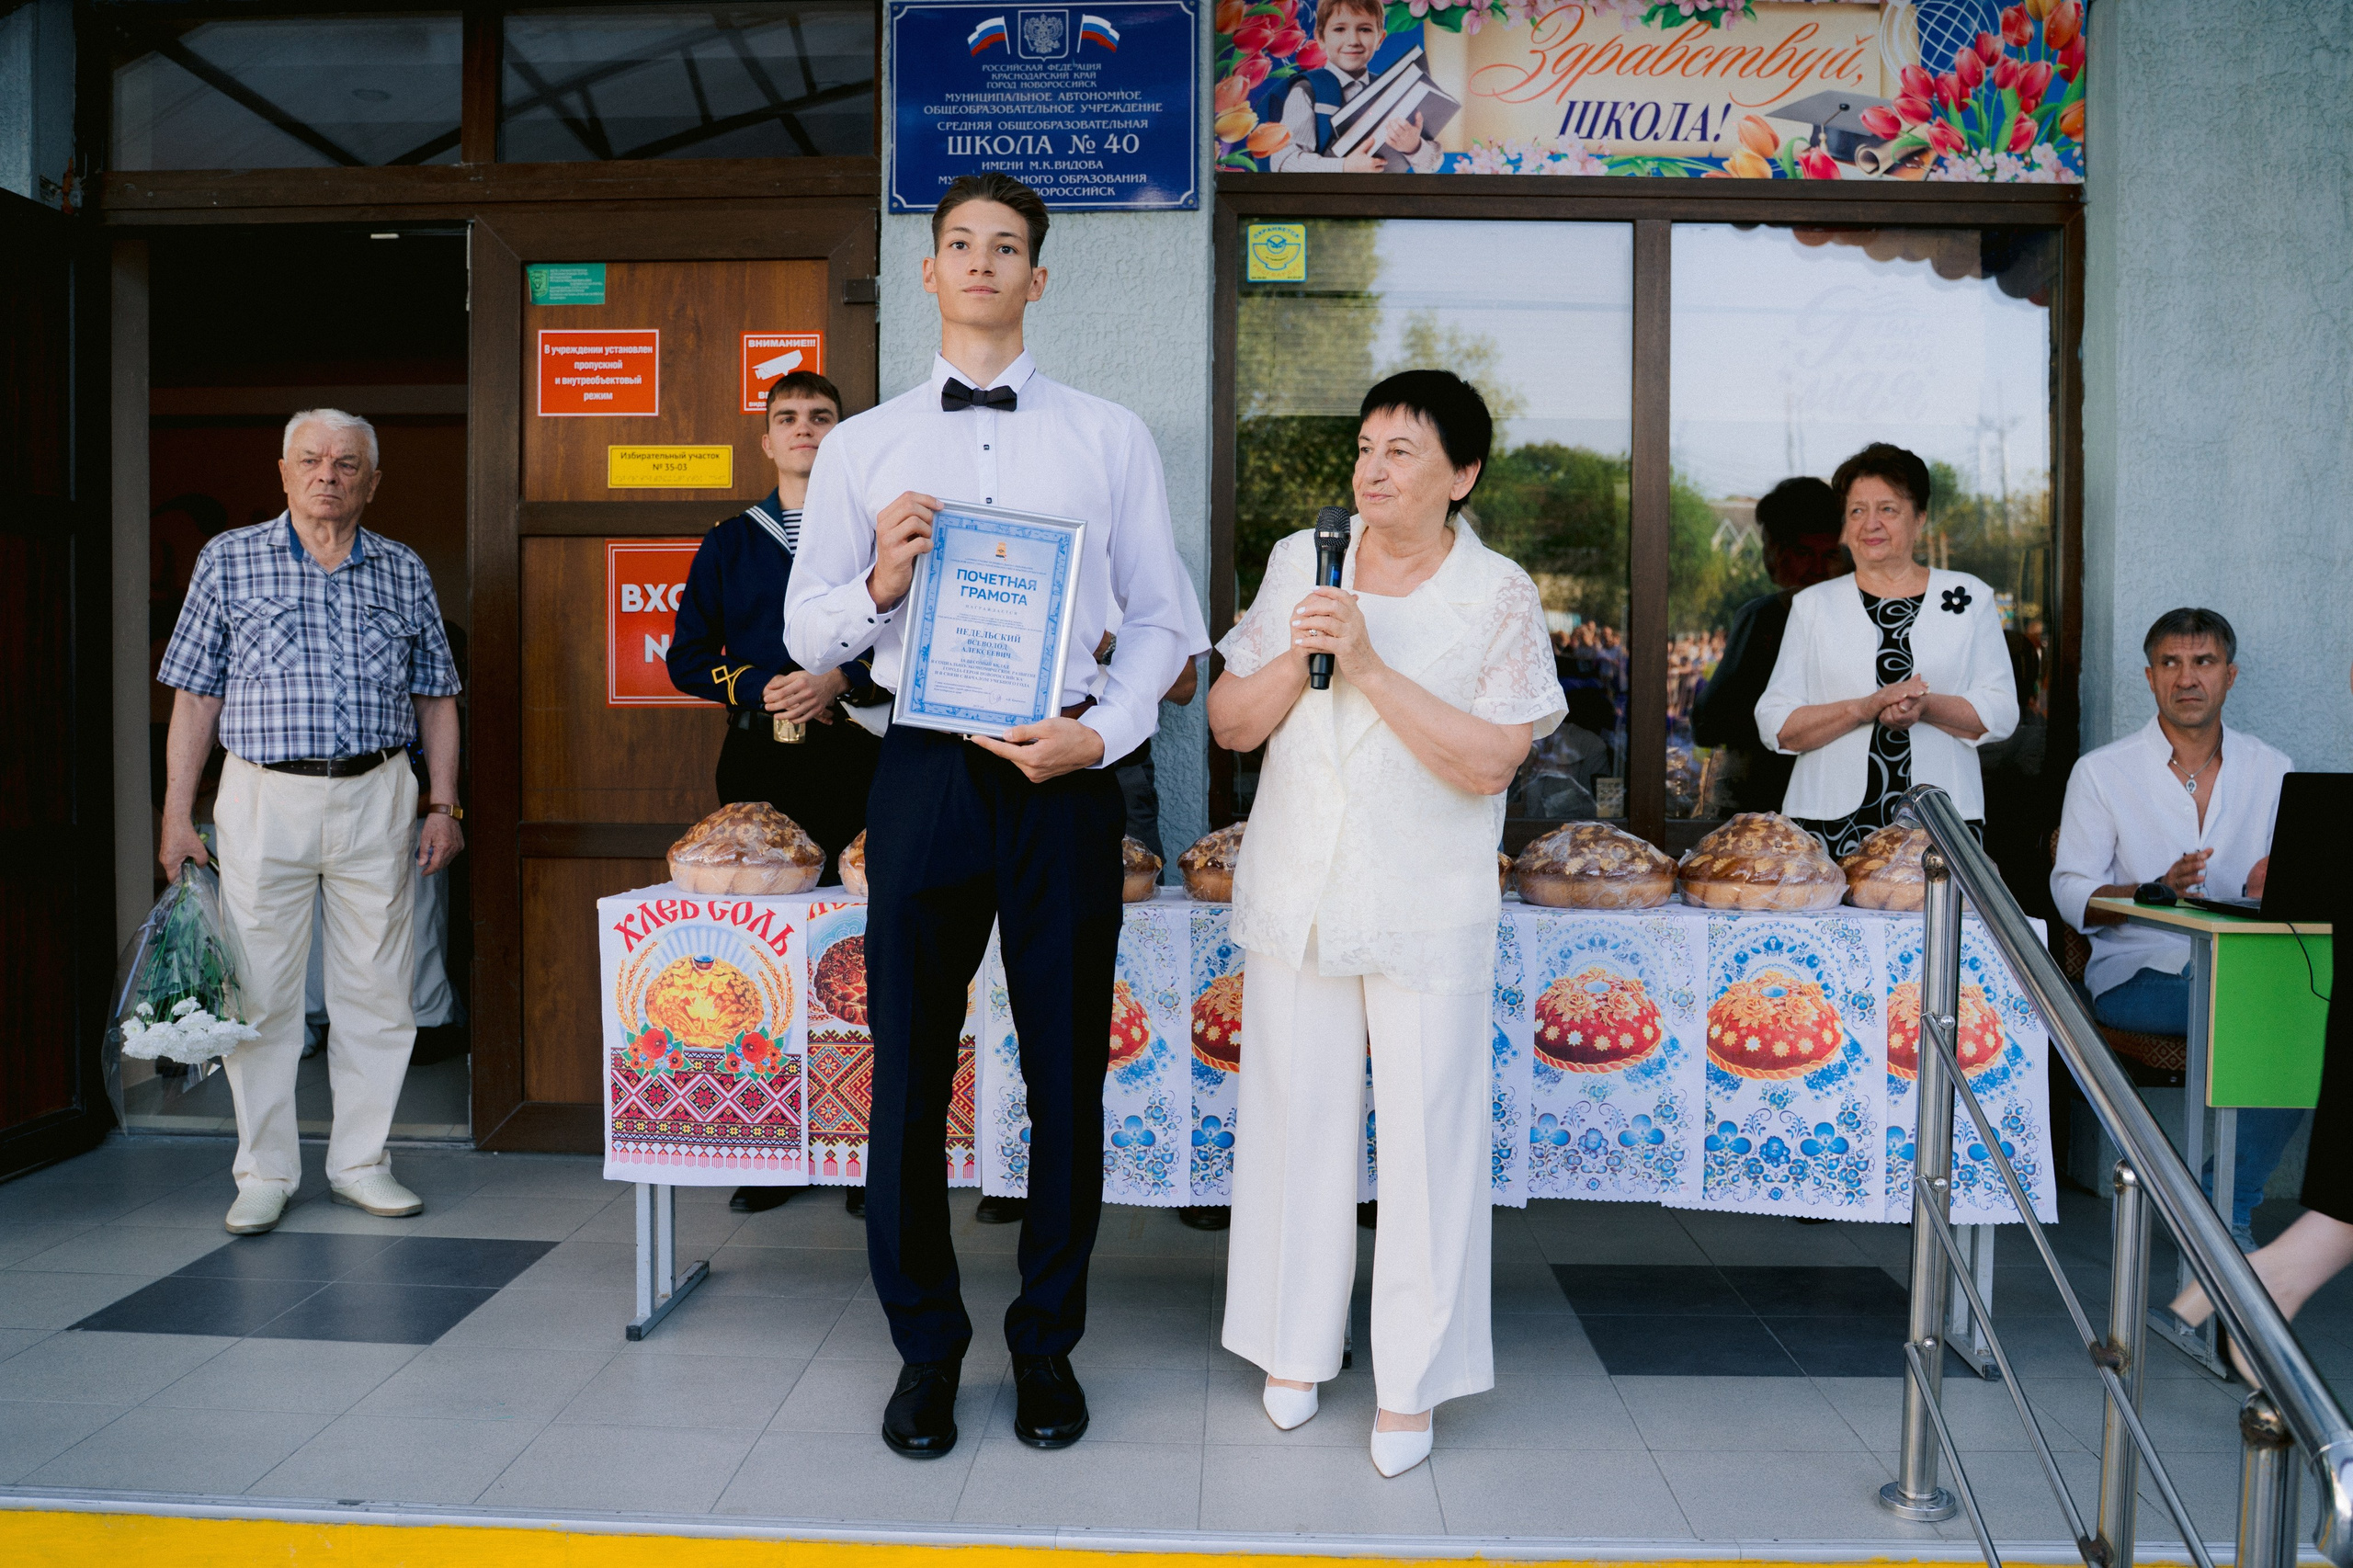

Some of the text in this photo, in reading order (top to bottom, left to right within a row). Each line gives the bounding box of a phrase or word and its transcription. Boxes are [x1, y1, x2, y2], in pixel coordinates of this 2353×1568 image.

[1469, 4, 1875, 108] Здравствуй,
[982, 62, 1102, 73] РОССИЙСКАЯ ФЕДЕРАЦИЯ
[991, 71, 1097, 81] КРАСНОДАРСКИЙ КРАЙ
[986, 80, 1097, 89] ГОРОД НОВОРОССИЙСК
[945, 90, 1142, 103] МУНИЦИПАЛЬНОЕ АВТОНОМНОЕ
[923, 102, 1164, 115] ОБЩЕОБРАЗОВАТЕЛЬНОЕ УЧРЕЖДЕНИЕ
[937, 119, 1149, 131] СРЕДНЯЯ ОБЩЕОБРАЗОВАТЕЛЬНАЯ
[1555, 99, 1733, 142] ШКОЛА!
[948, 133, 1141, 155] ШКОЛА № 40
[982, 160, 1104, 171] ИМЕНИ М.К.ВИДОВА
[1058, 173, 1148, 185] ОБРАЗОВАНИЯ
[1035, 187, 1116, 198] ВОРОССИЙСК
[748, 339, 816, 348] ВНИМАНИЕ!!!
[544, 345, 654, 357] В учреждении установлен
[574, 359, 623, 371] пропускной
[583, 392, 613, 402] режим
[620, 451, 720, 461] Избирательный участок
[653, 463, 688, 472] № 35-03
[956, 568, 1038, 591] ПОЧЕТНАЯ
[961, 585, 1028, 607] ГРАМОТА
[956, 627, 1021, 644] НЕДЕЛЬСКИЙ
[967, 639, 1008, 652] ВСЕВОЛОД
[961, 646, 1012, 659] АЛЕКСЕЕВИЧ
